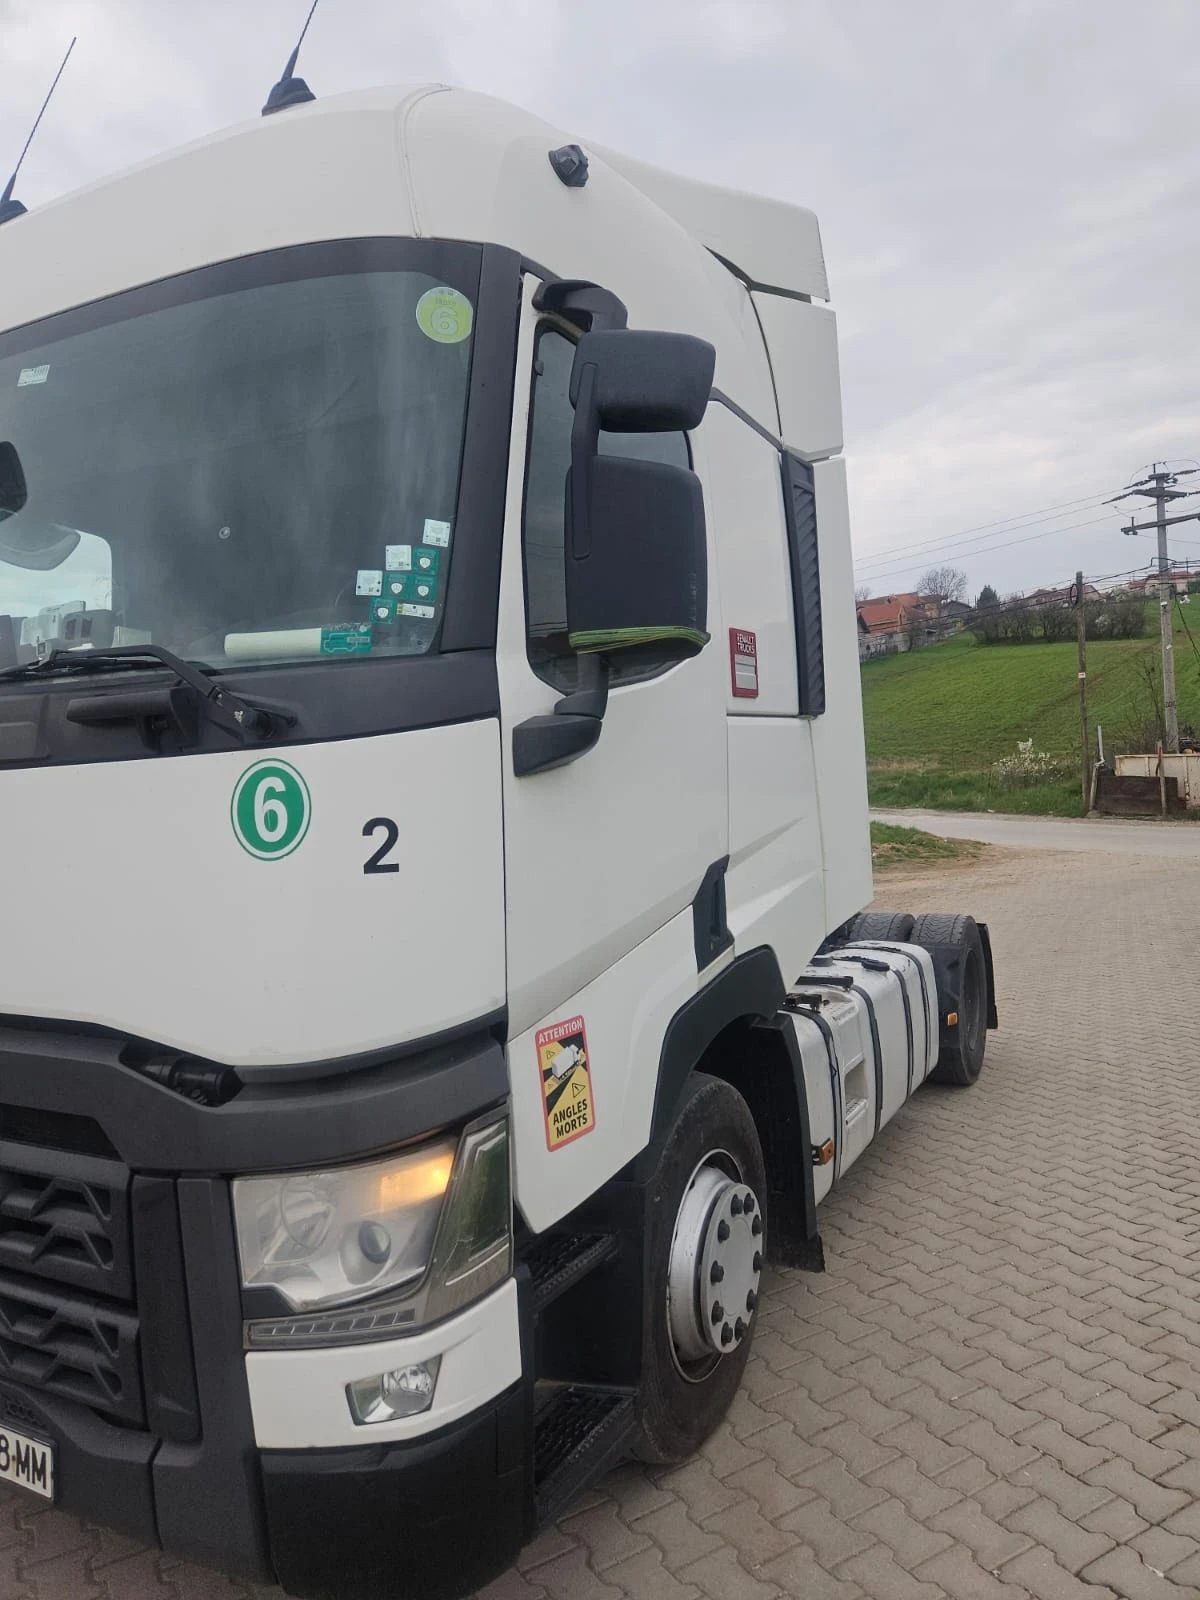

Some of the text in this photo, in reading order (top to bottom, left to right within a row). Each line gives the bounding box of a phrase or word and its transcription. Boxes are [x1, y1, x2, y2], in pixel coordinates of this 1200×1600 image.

[430, 306, 459, 335] 6
[737, 642, 755, 654] TRUCKS
[254, 776, 288, 843] 6
[362, 817, 399, 874] 2
[538, 1018, 583, 1044] ATTENTION
[553, 1098, 588, 1125] ANGLES
[555, 1113, 588, 1139] MORTS
